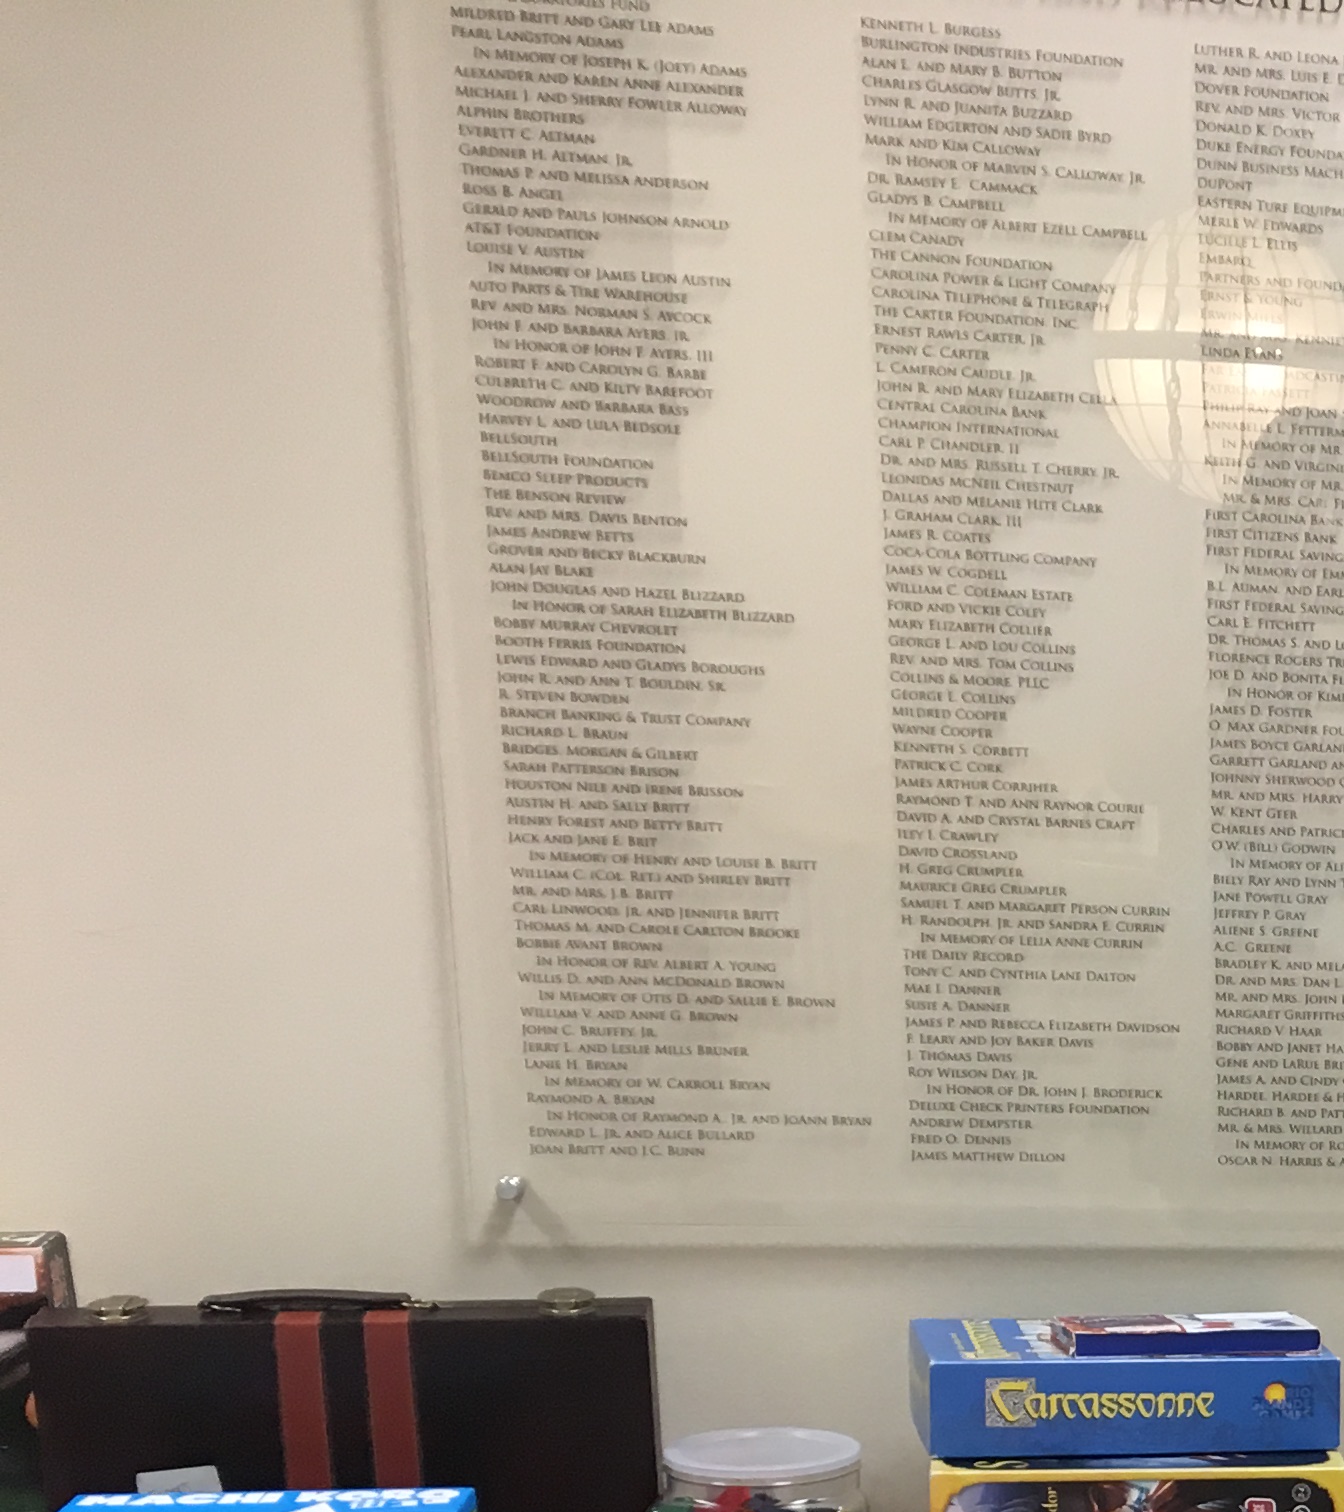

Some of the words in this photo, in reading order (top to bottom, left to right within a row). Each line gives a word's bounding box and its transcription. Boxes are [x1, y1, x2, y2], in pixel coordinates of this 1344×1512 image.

[1194, 81, 1240, 95] DOVER
[1244, 85, 1330, 102] FOUNDATION
[991, 1381, 1215, 1421] Carcassonne
